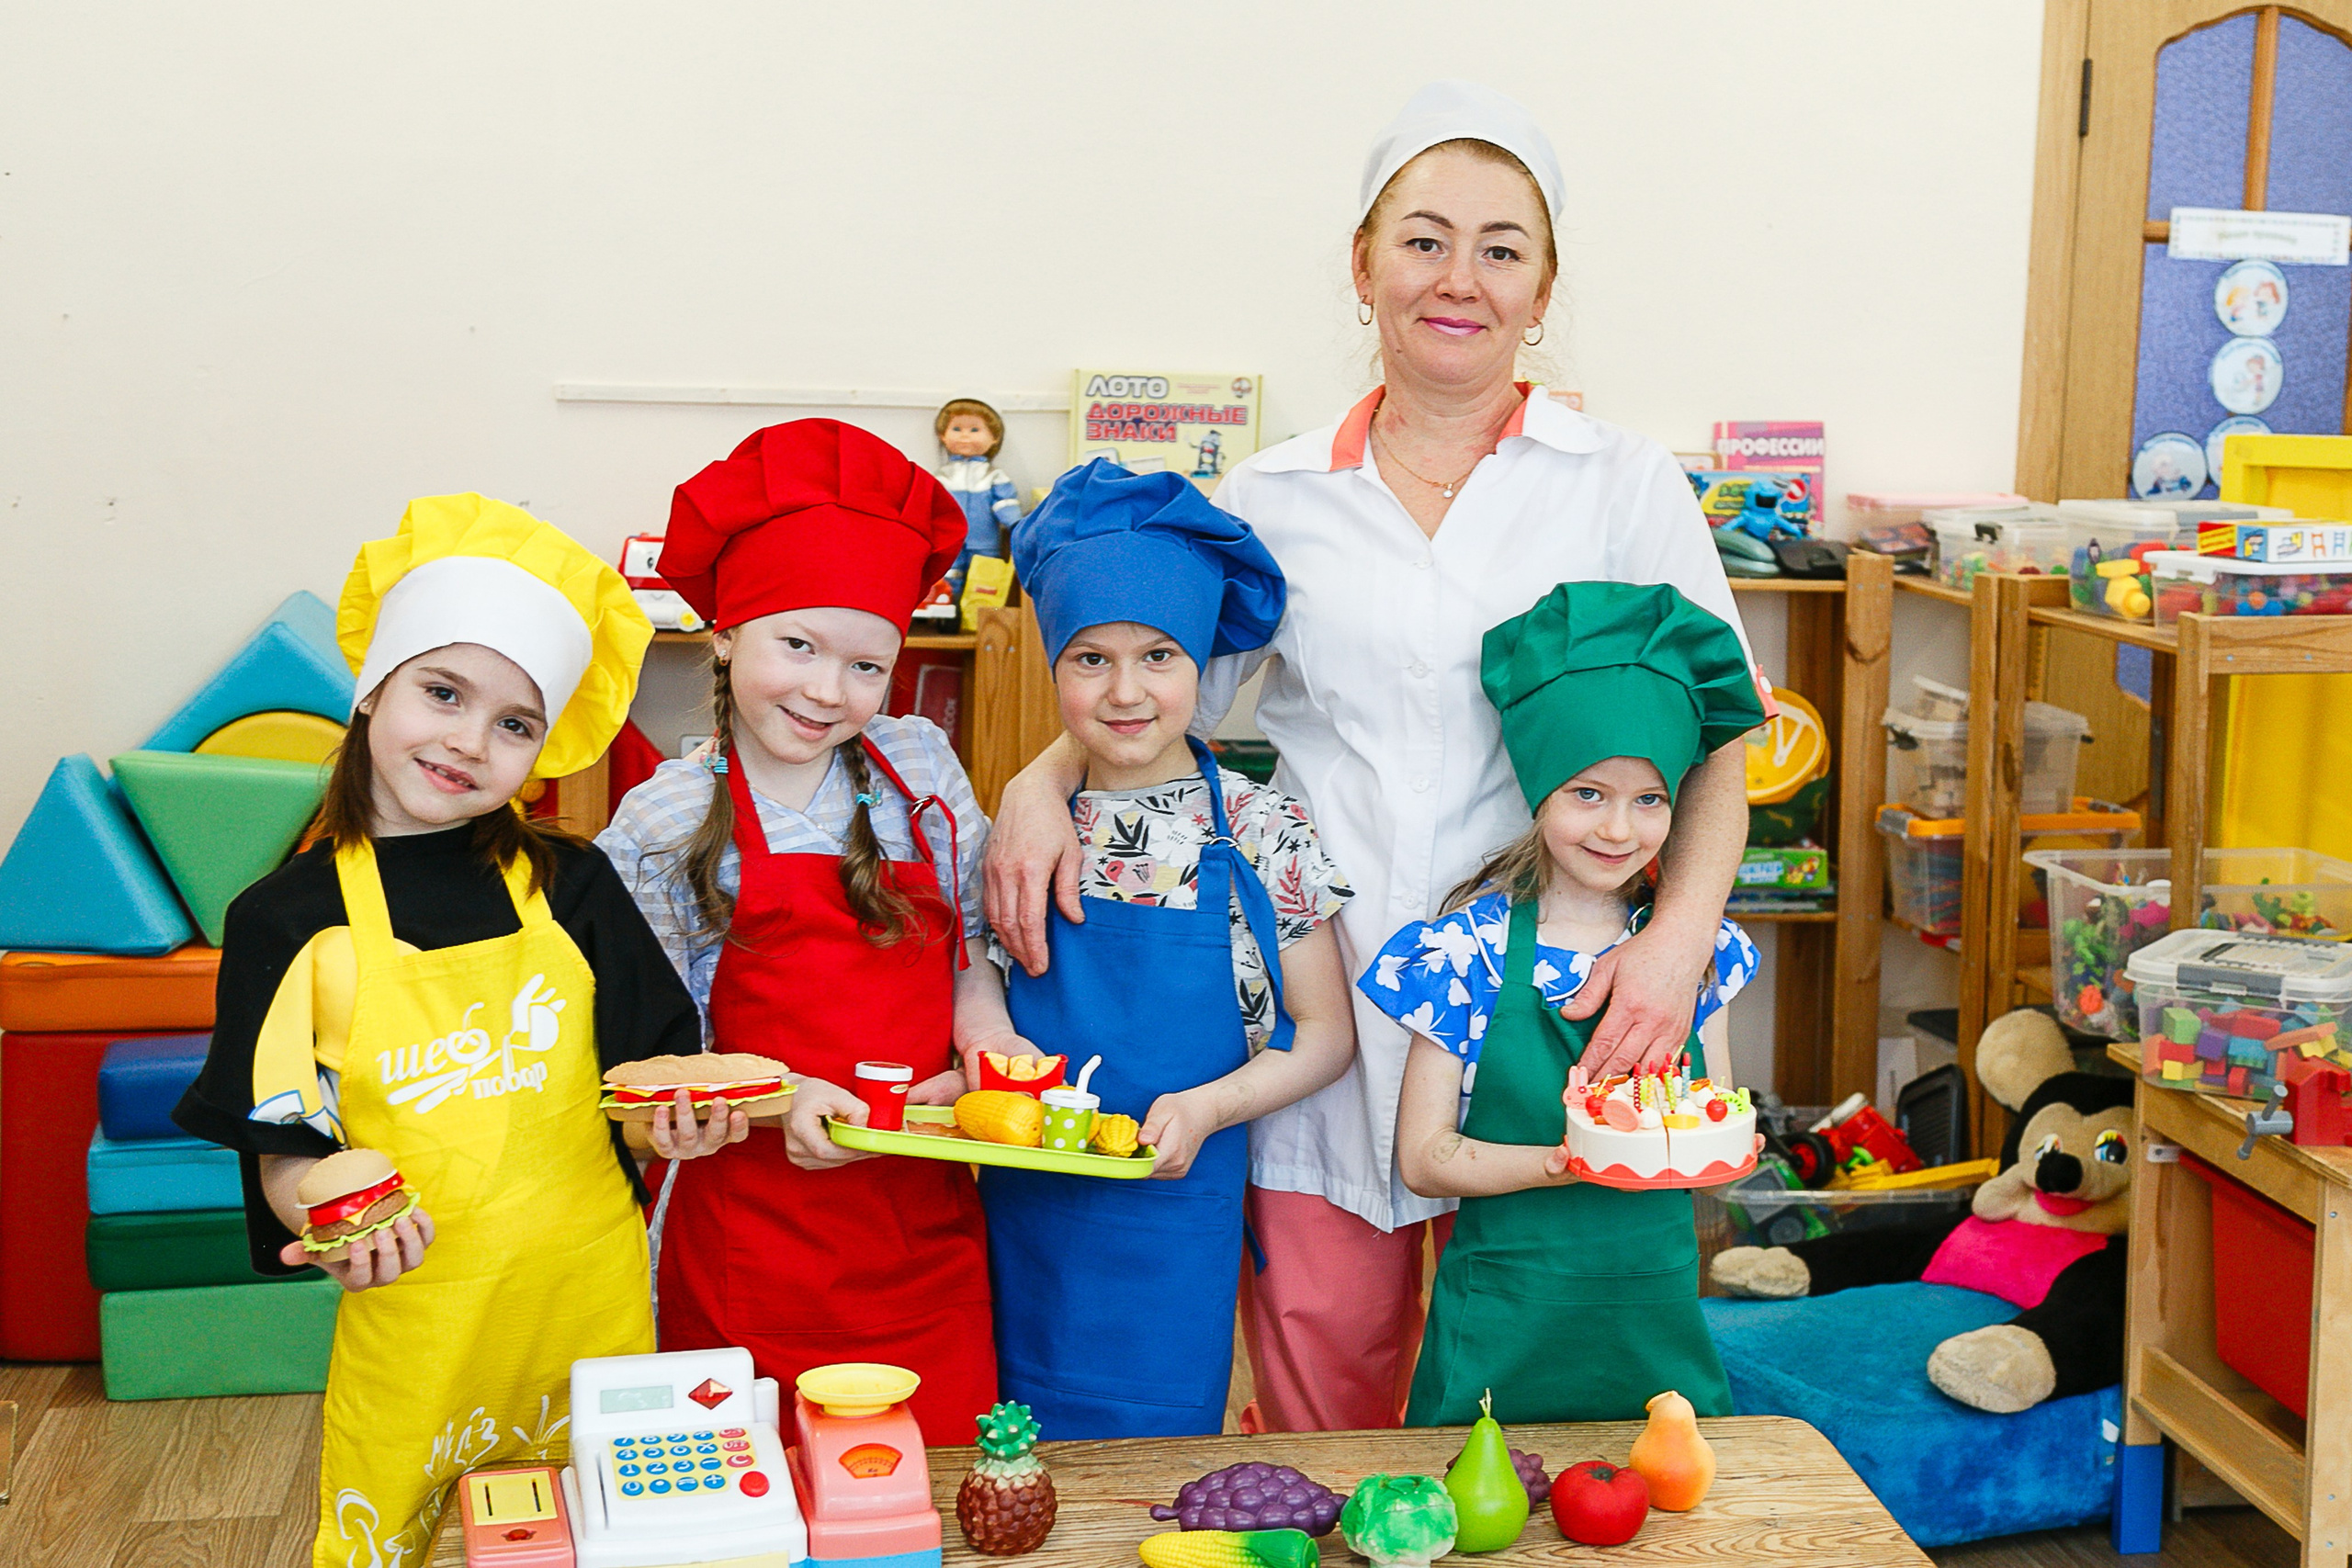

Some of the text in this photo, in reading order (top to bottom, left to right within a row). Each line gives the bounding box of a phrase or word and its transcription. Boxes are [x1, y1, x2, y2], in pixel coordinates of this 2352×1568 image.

[1086, 375, 1169, 399] ЛОТО
[1086, 401, 1248, 425] ДОРОЖНЫЕ
[1086, 421, 1177, 443] ЗНАКИ
[1717, 436, 1824, 457] ПРОФЕССИИ
[471, 1036, 548, 1100] повар
